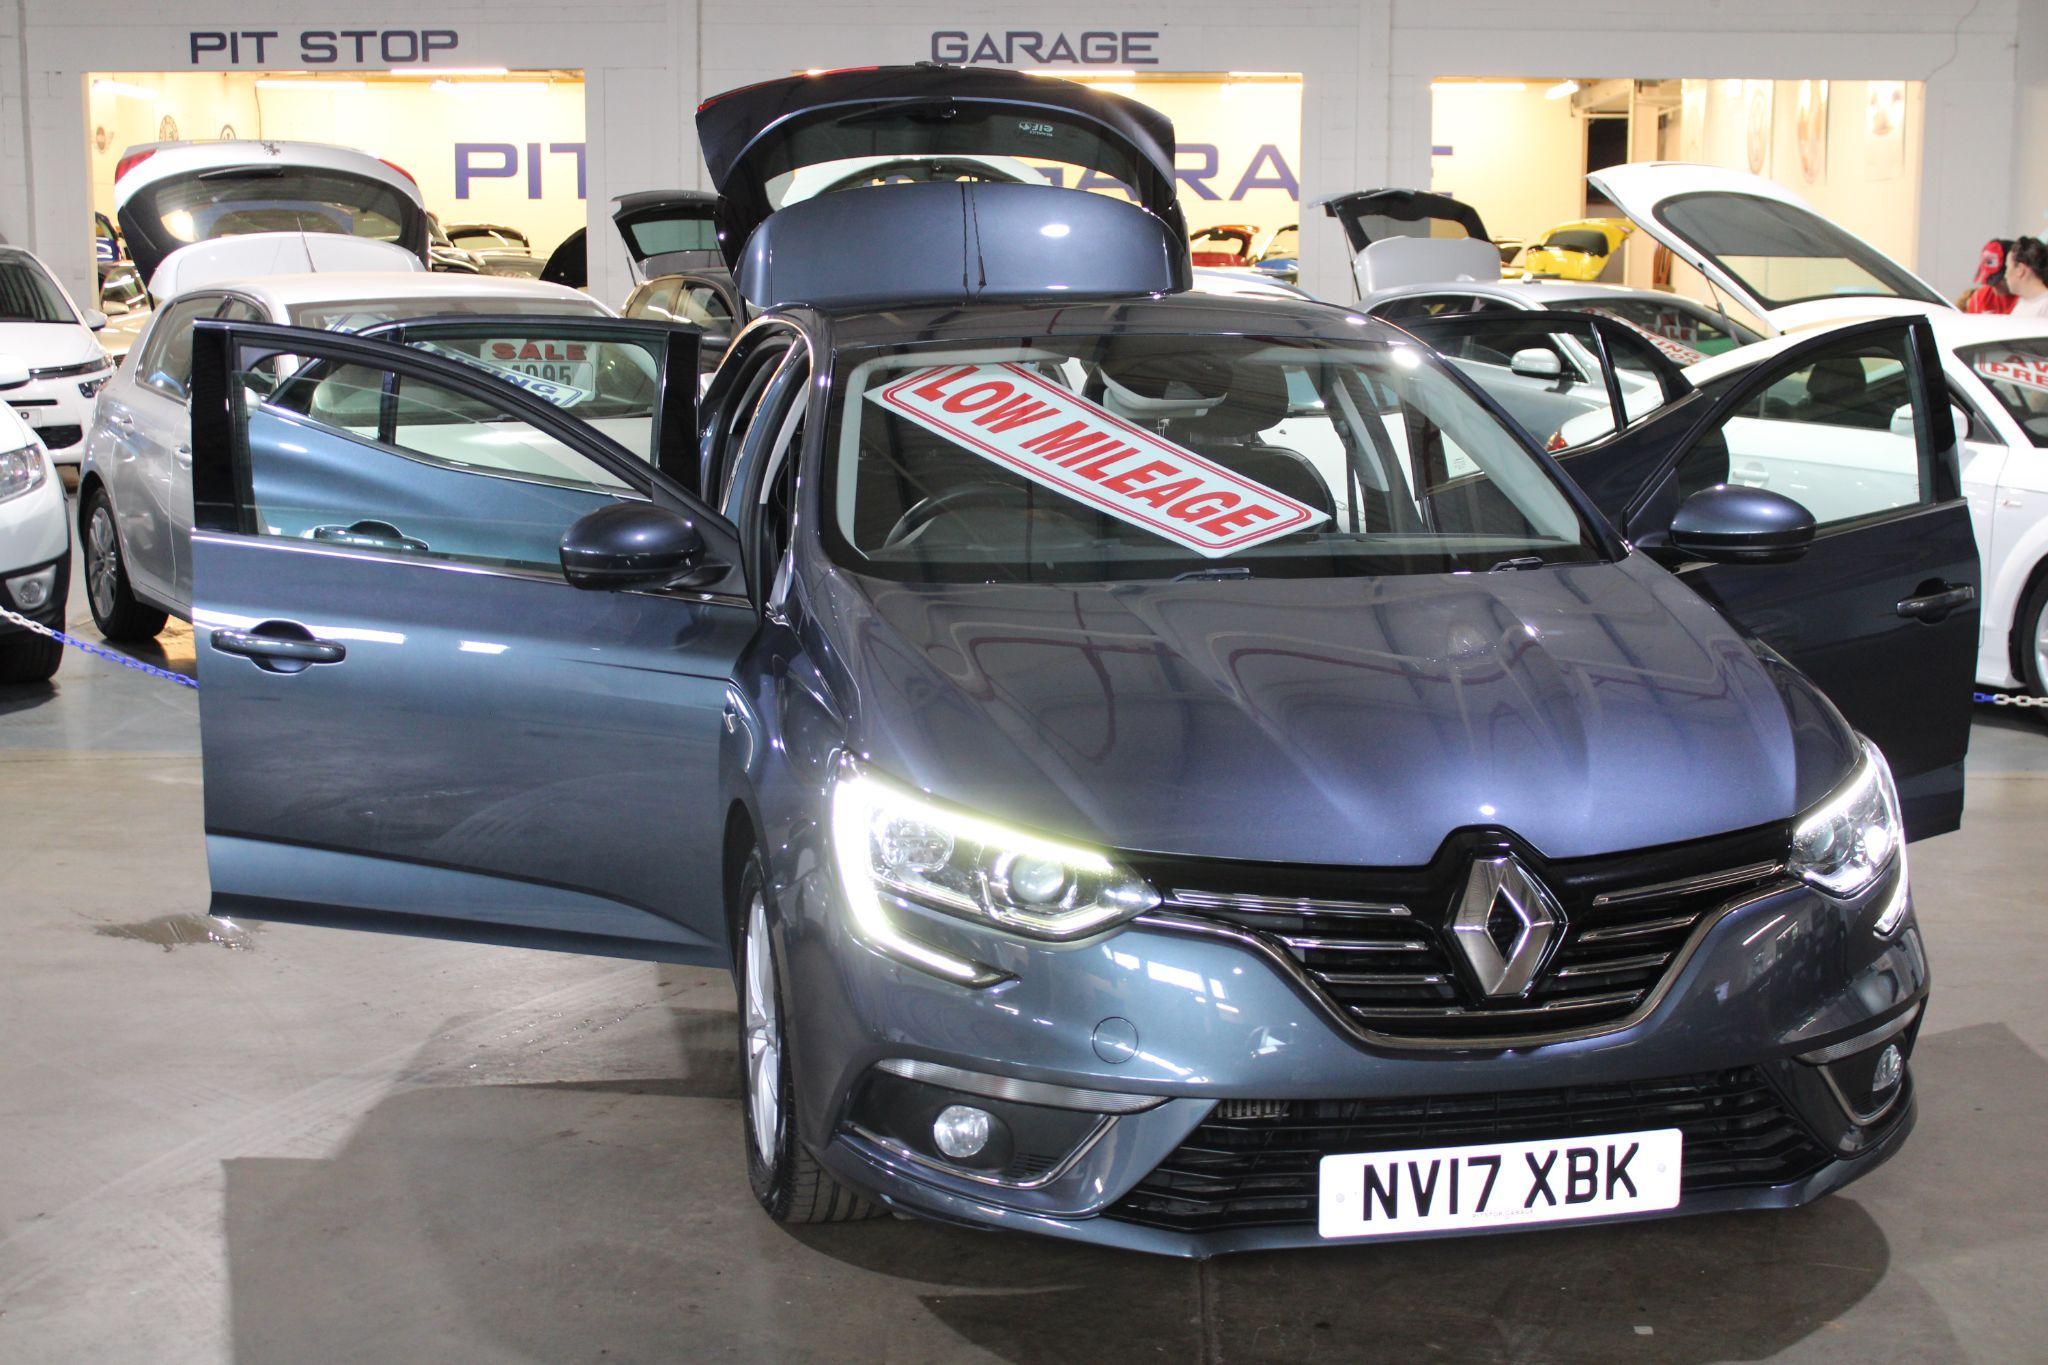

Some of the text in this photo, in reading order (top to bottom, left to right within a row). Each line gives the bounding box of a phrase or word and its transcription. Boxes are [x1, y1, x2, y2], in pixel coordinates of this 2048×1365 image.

[189, 30, 459, 64] PIT STOP
[931, 31, 1160, 64] GARAGE
[455, 142, 587, 200] PIT
[491, 342, 587, 361] SALE
[912, 366, 1282, 537] LOW MILEAGE
[1362, 1142, 1640, 1221] NV17 XBK
